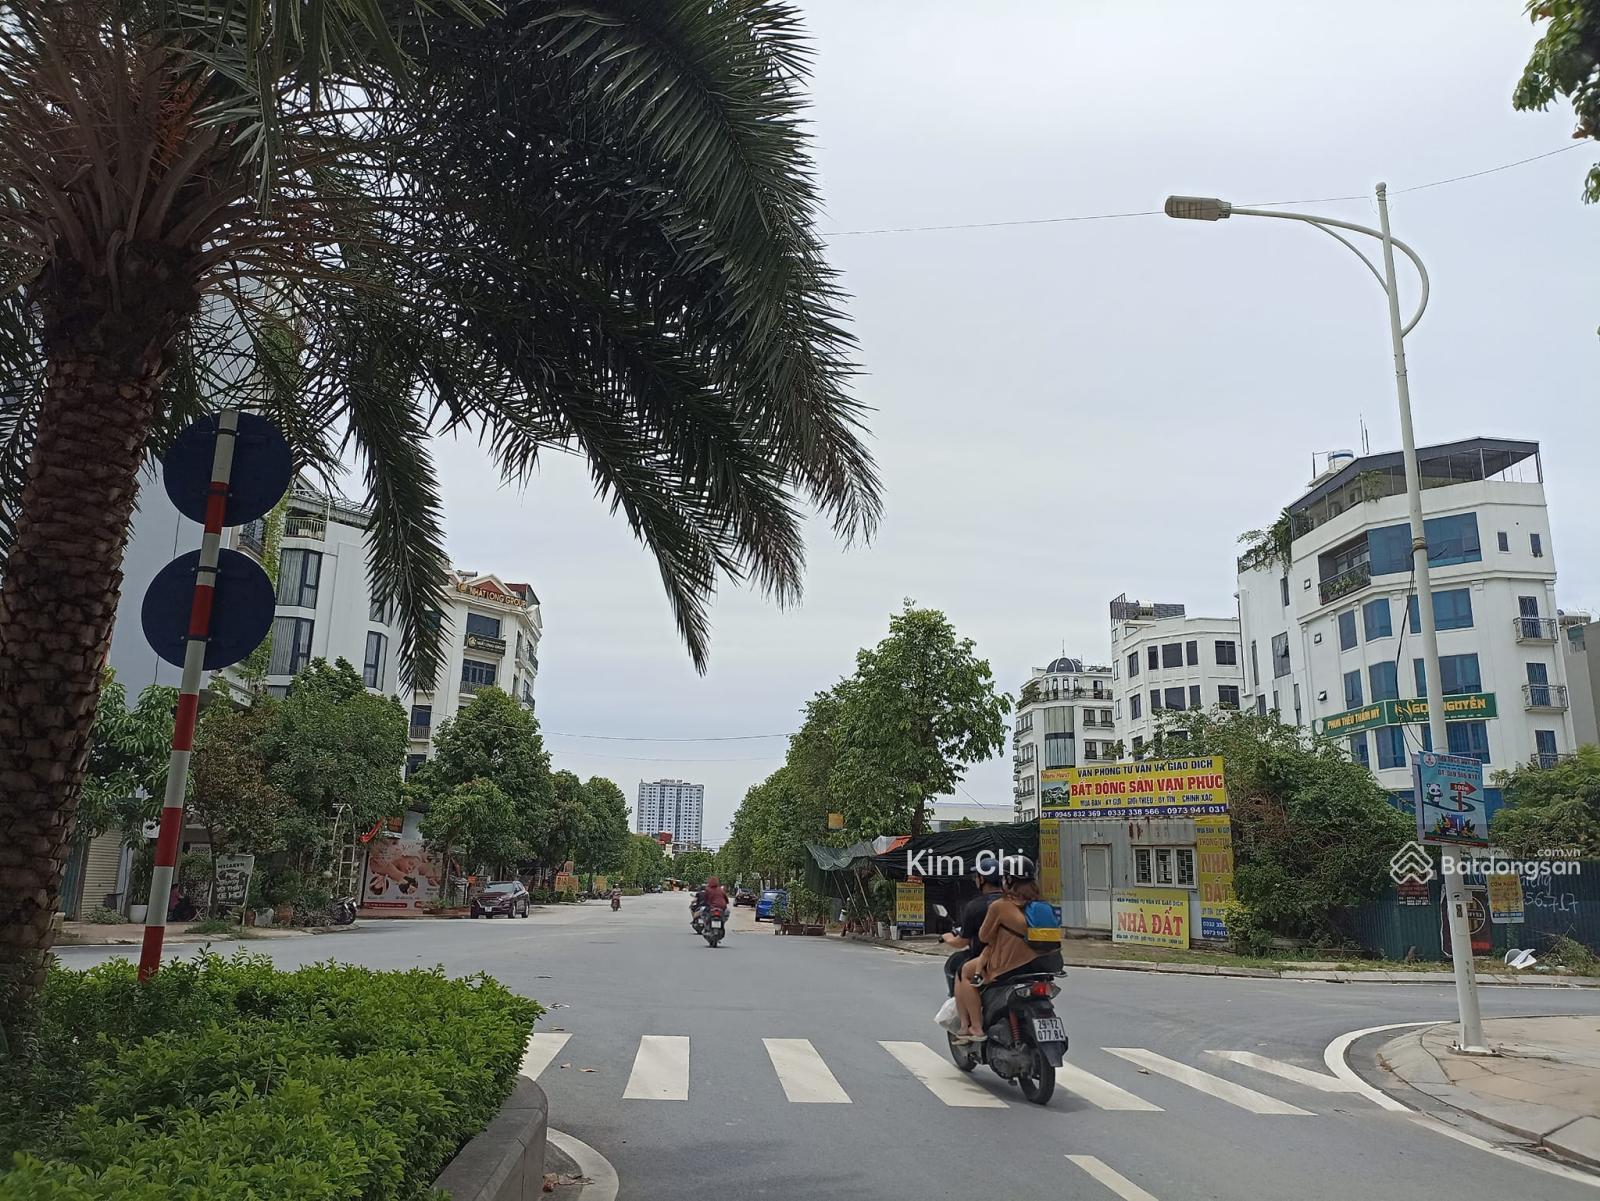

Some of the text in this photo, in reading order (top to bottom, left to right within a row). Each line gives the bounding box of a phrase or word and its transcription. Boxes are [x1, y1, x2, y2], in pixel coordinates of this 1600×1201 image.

[505, 595, 527, 607] GROUP
[1168, 761, 1188, 771] GIAO
[1157, 776, 1184, 793] VẠN
[1187, 773, 1223, 790] PHÚC
[1055, 810, 1071, 818] 0945
[1088, 809, 1101, 817] 369
[1128, 808, 1143, 816] 338
[1144, 807, 1160, 815] 566
[1208, 805, 1225, 813] 031
[1117, 906, 1183, 937] NHÀ ĐẤT
